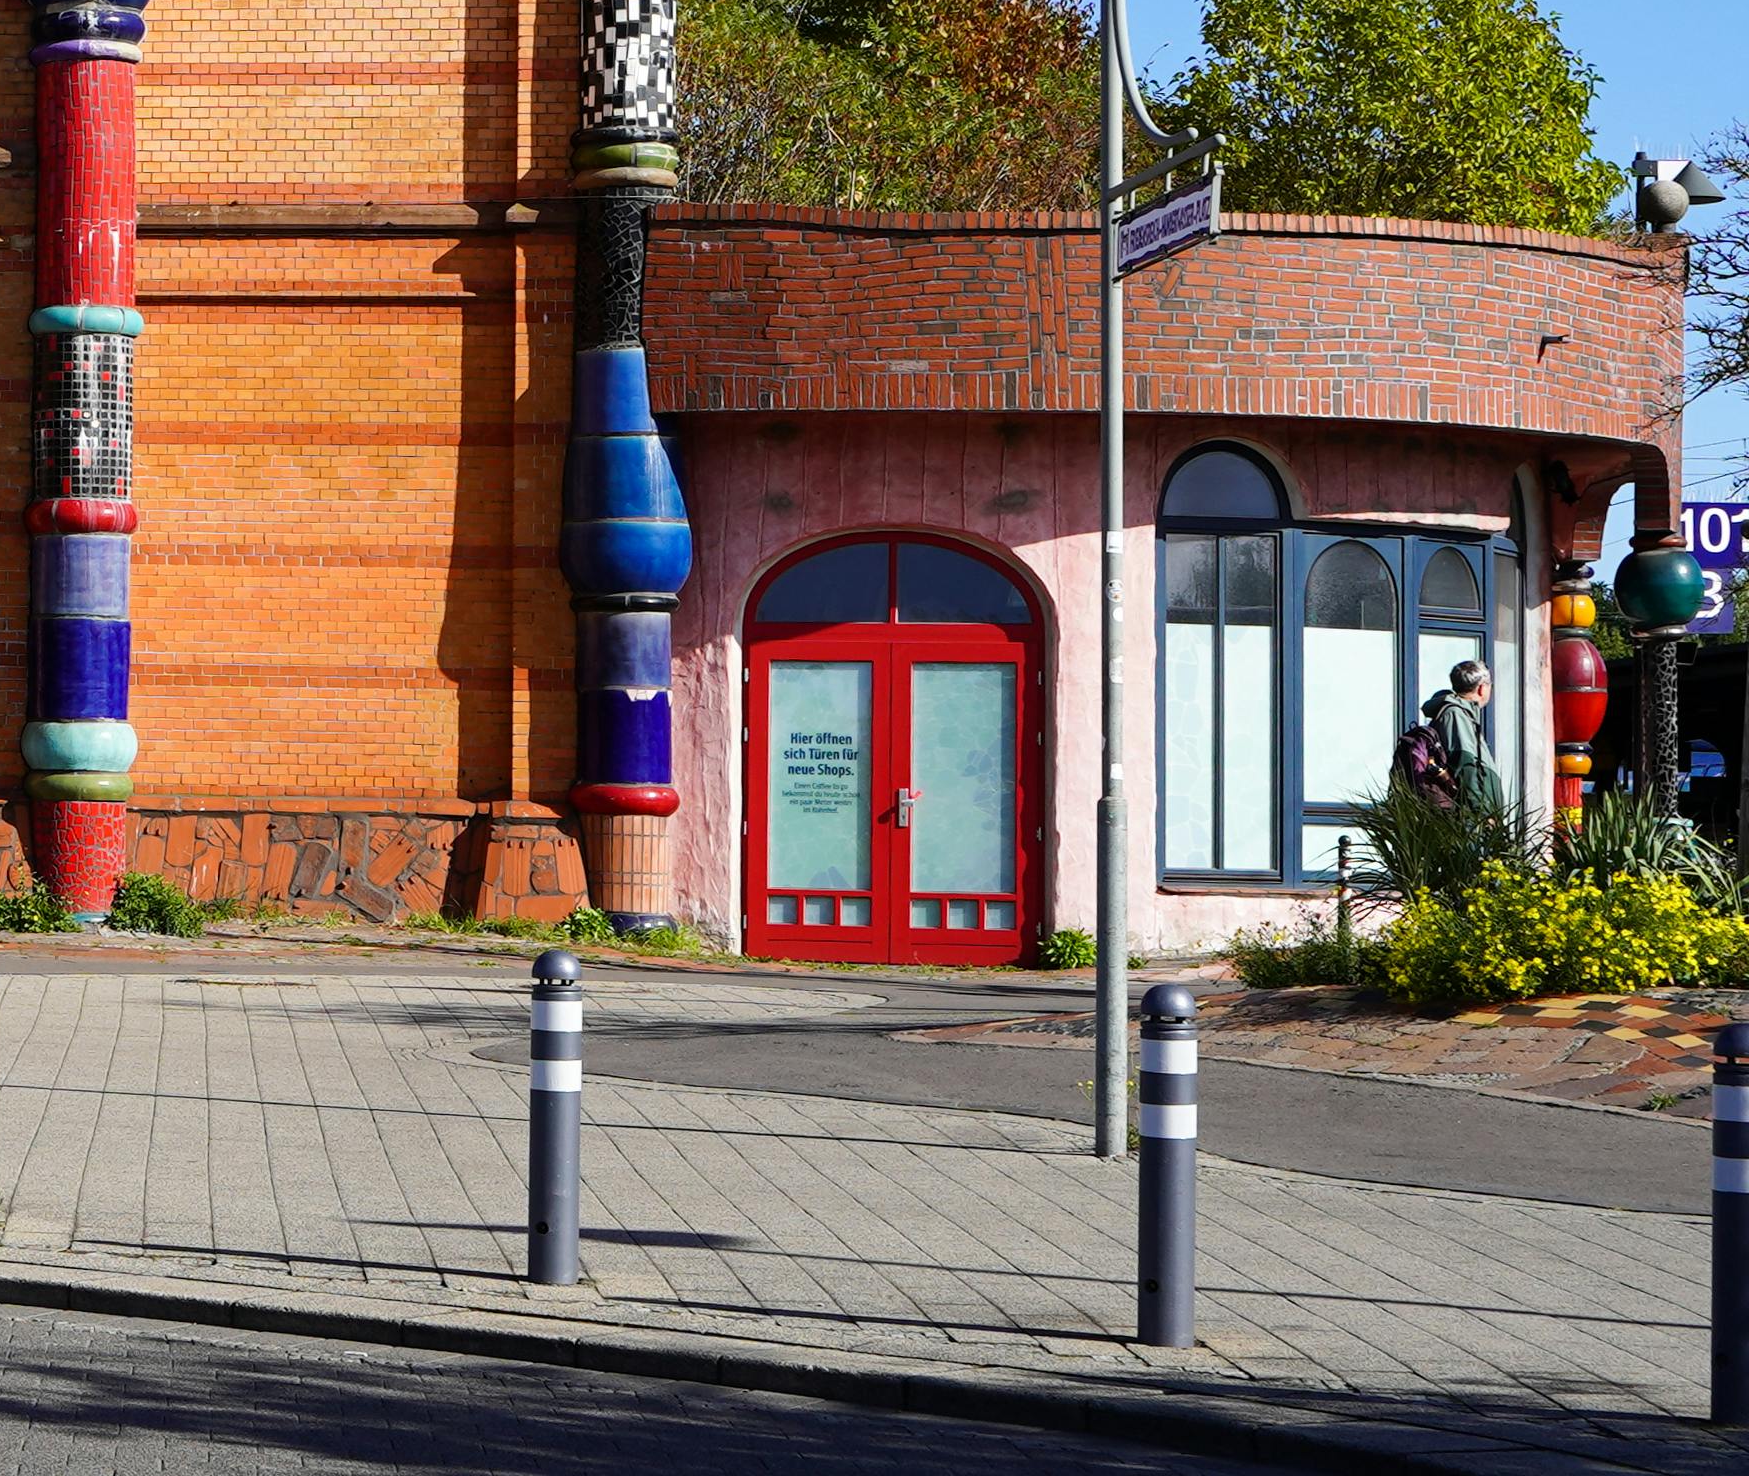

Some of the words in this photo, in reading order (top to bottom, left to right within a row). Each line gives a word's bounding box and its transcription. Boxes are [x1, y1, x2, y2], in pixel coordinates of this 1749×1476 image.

[790, 732, 813, 744] Hier
[816, 732, 852, 744] öffnen
[783, 748, 806, 760] sich
[809, 748, 840, 760] Türen
[842, 748, 859, 760] für
[788, 765, 815, 775] neue
[817, 763, 854, 778] Shops.
